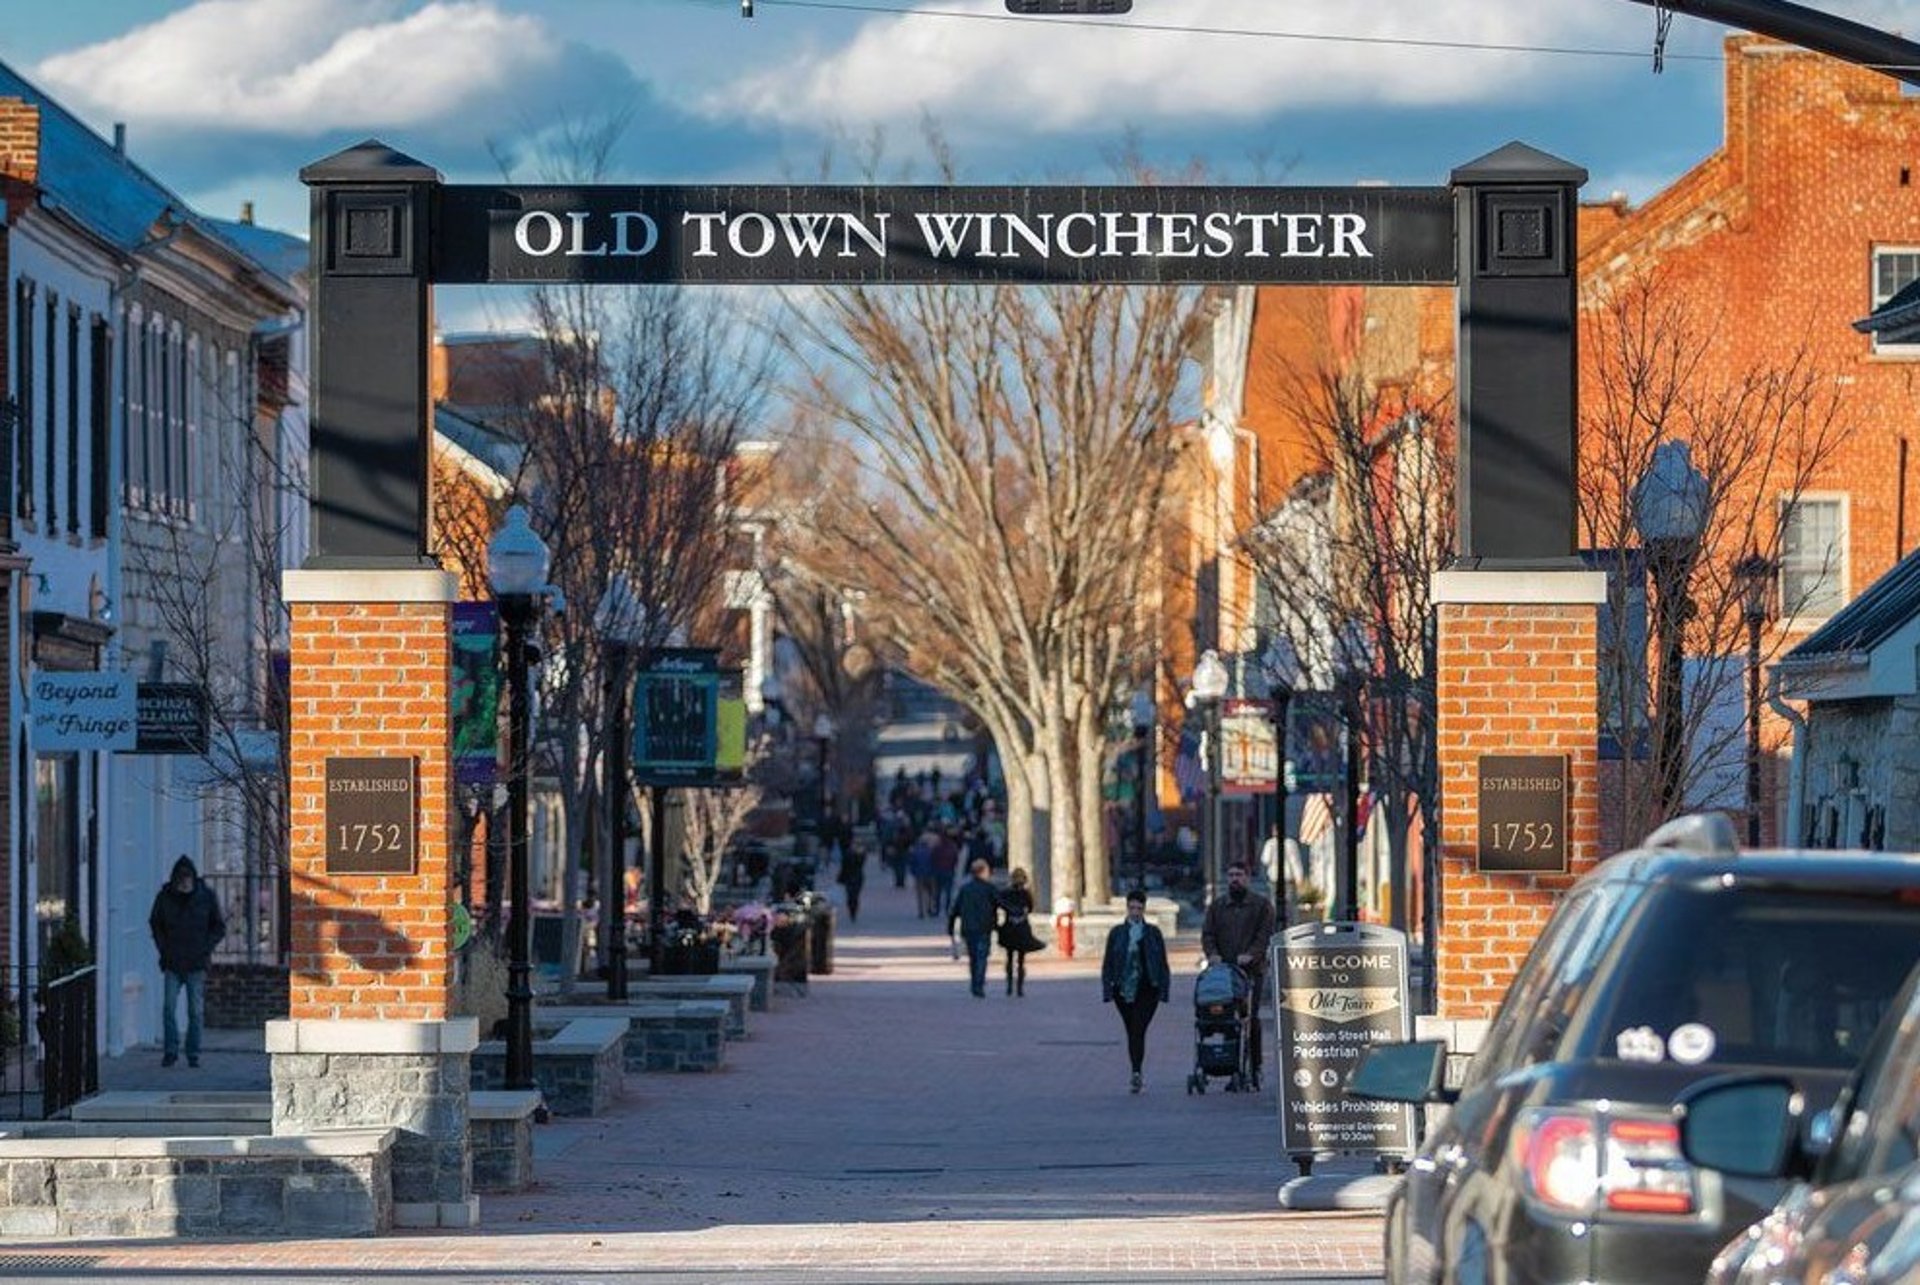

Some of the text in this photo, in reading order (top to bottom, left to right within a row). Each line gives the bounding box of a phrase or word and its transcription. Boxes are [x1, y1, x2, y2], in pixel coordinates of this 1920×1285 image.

[514, 210, 1374, 259] OLD TOWN WINCHESTER
[36, 681, 119, 706] Beyond
[57, 713, 130, 740] Fringe
[329, 778, 408, 792] ESTABLISHED
[1482, 776, 1562, 791] ESTABLISHED
[338, 823, 402, 854] 1752
[1491, 822, 1555, 853] 1752
[1287, 954, 1392, 970] WELCOME
[1330, 972, 1349, 983] TO
[1292, 1029, 1392, 1041] Loudoun Street Mall
[1292, 1046, 1359, 1059] Pedestrian
[1291, 1101, 1399, 1113] Vehicles Prohibited
[1308, 1121, 1355, 1132] Commercial
[1357, 1121, 1397, 1131] Deliveries
